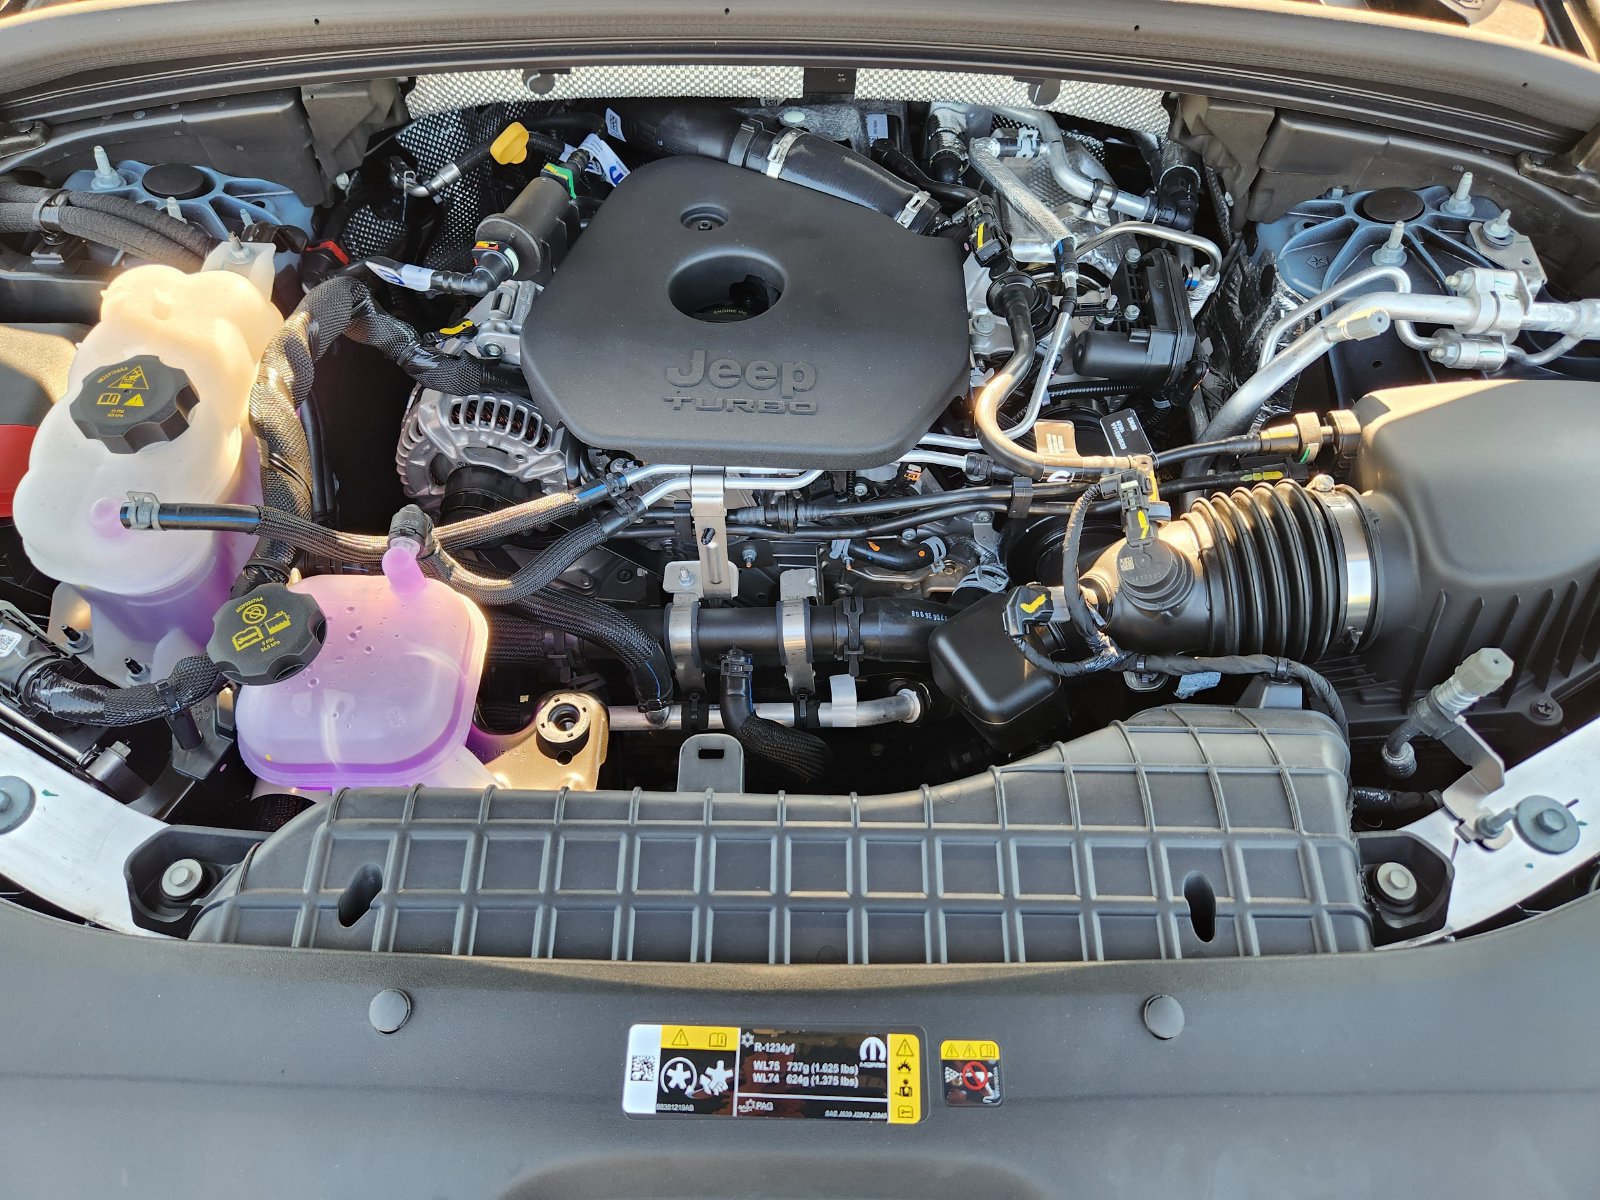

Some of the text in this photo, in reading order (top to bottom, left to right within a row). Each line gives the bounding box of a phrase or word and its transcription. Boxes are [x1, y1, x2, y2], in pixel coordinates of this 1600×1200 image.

[665, 348, 817, 399] Jeep
[663, 395, 818, 415] TURBO
[753, 1042, 796, 1055] R-1234yf
[752, 1060, 859, 1076] WL75 737g (1.625 lbs)
[752, 1073, 859, 1088] WL74 624g (1.375 lbs)
[755, 1101, 774, 1111] PAG
